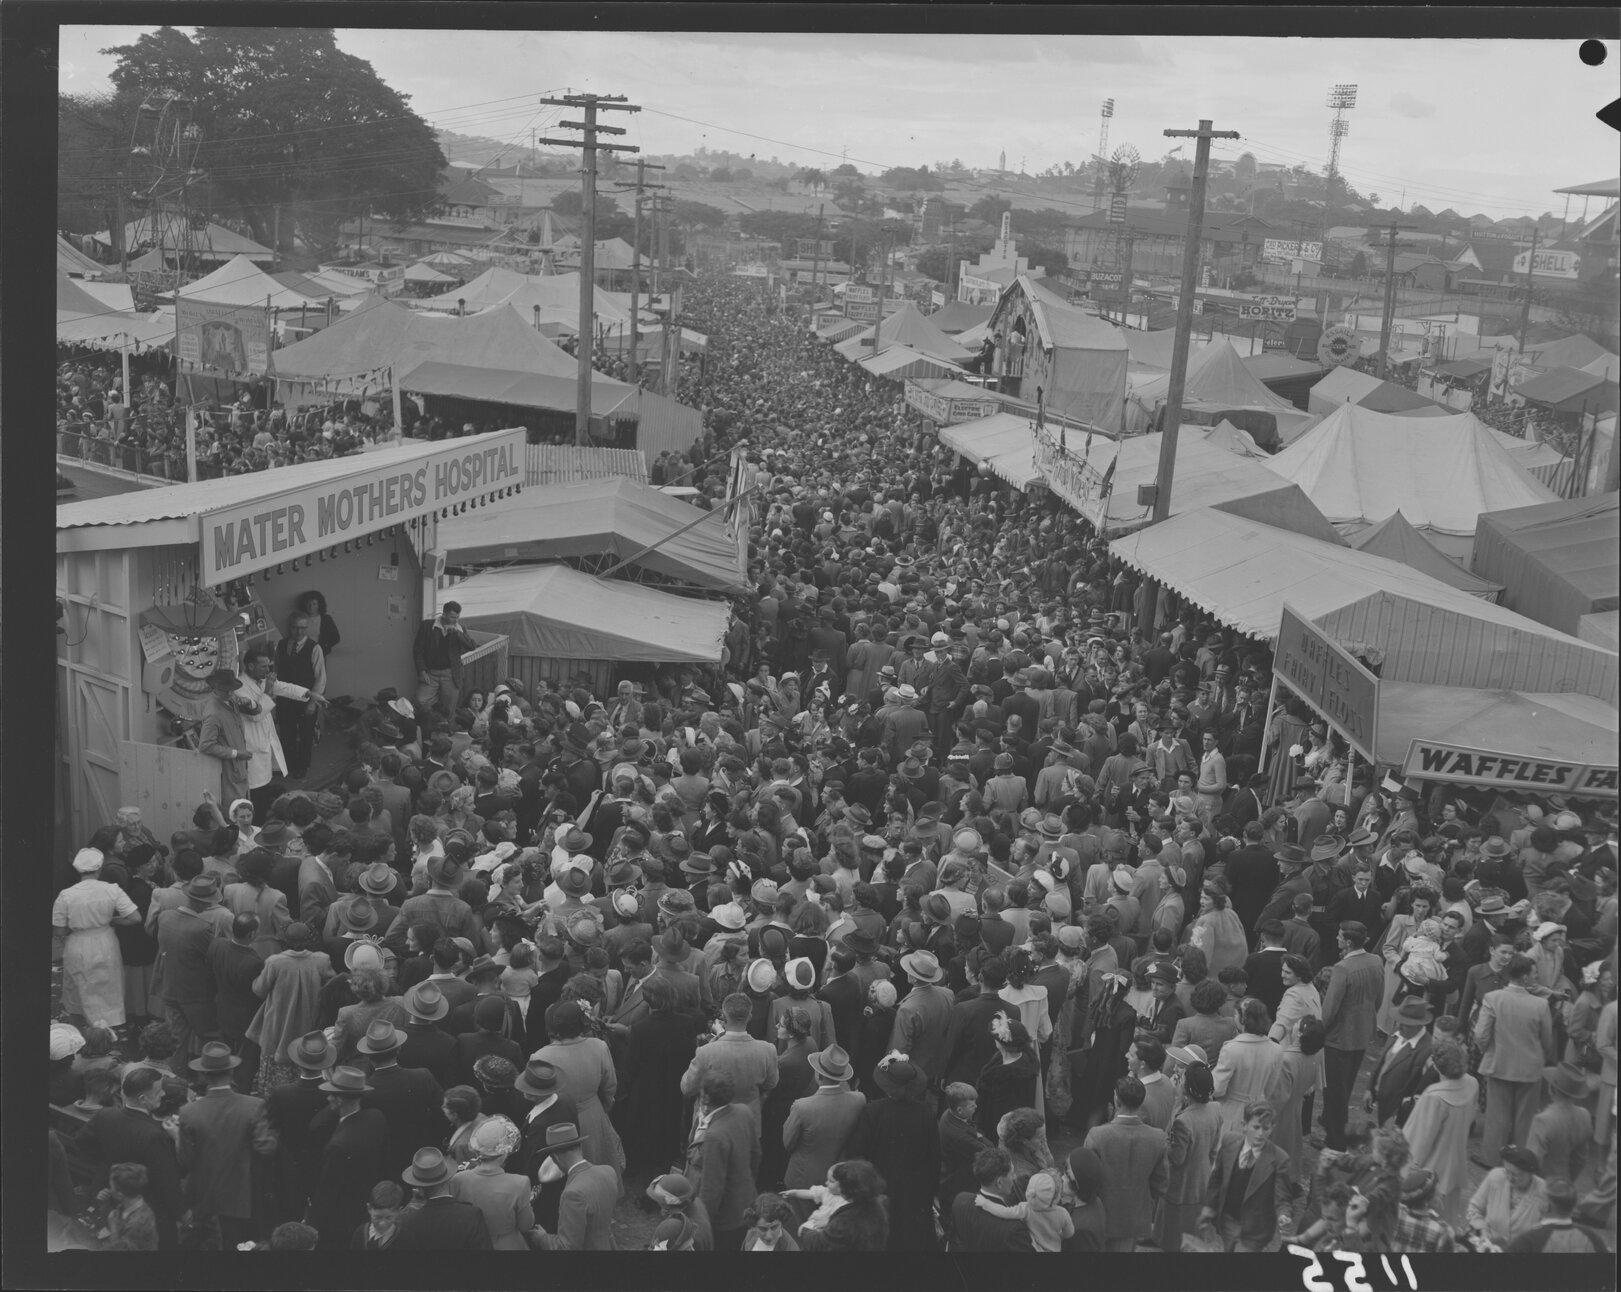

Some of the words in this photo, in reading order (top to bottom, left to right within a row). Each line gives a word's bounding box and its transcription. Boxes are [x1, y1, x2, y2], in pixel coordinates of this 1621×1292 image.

[1533, 254, 1567, 272] SHELL
[214, 504, 306, 571] MATER
[318, 461, 429, 537] MOTHERS'
[435, 443, 518, 500] HOSPITAL
[1301, 632, 1350, 692] WAFFLES
[1284, 651, 1317, 693] FAIRY
[1329, 690, 1364, 740] FLOSS
[1420, 747, 1573, 785] WAFFLES
